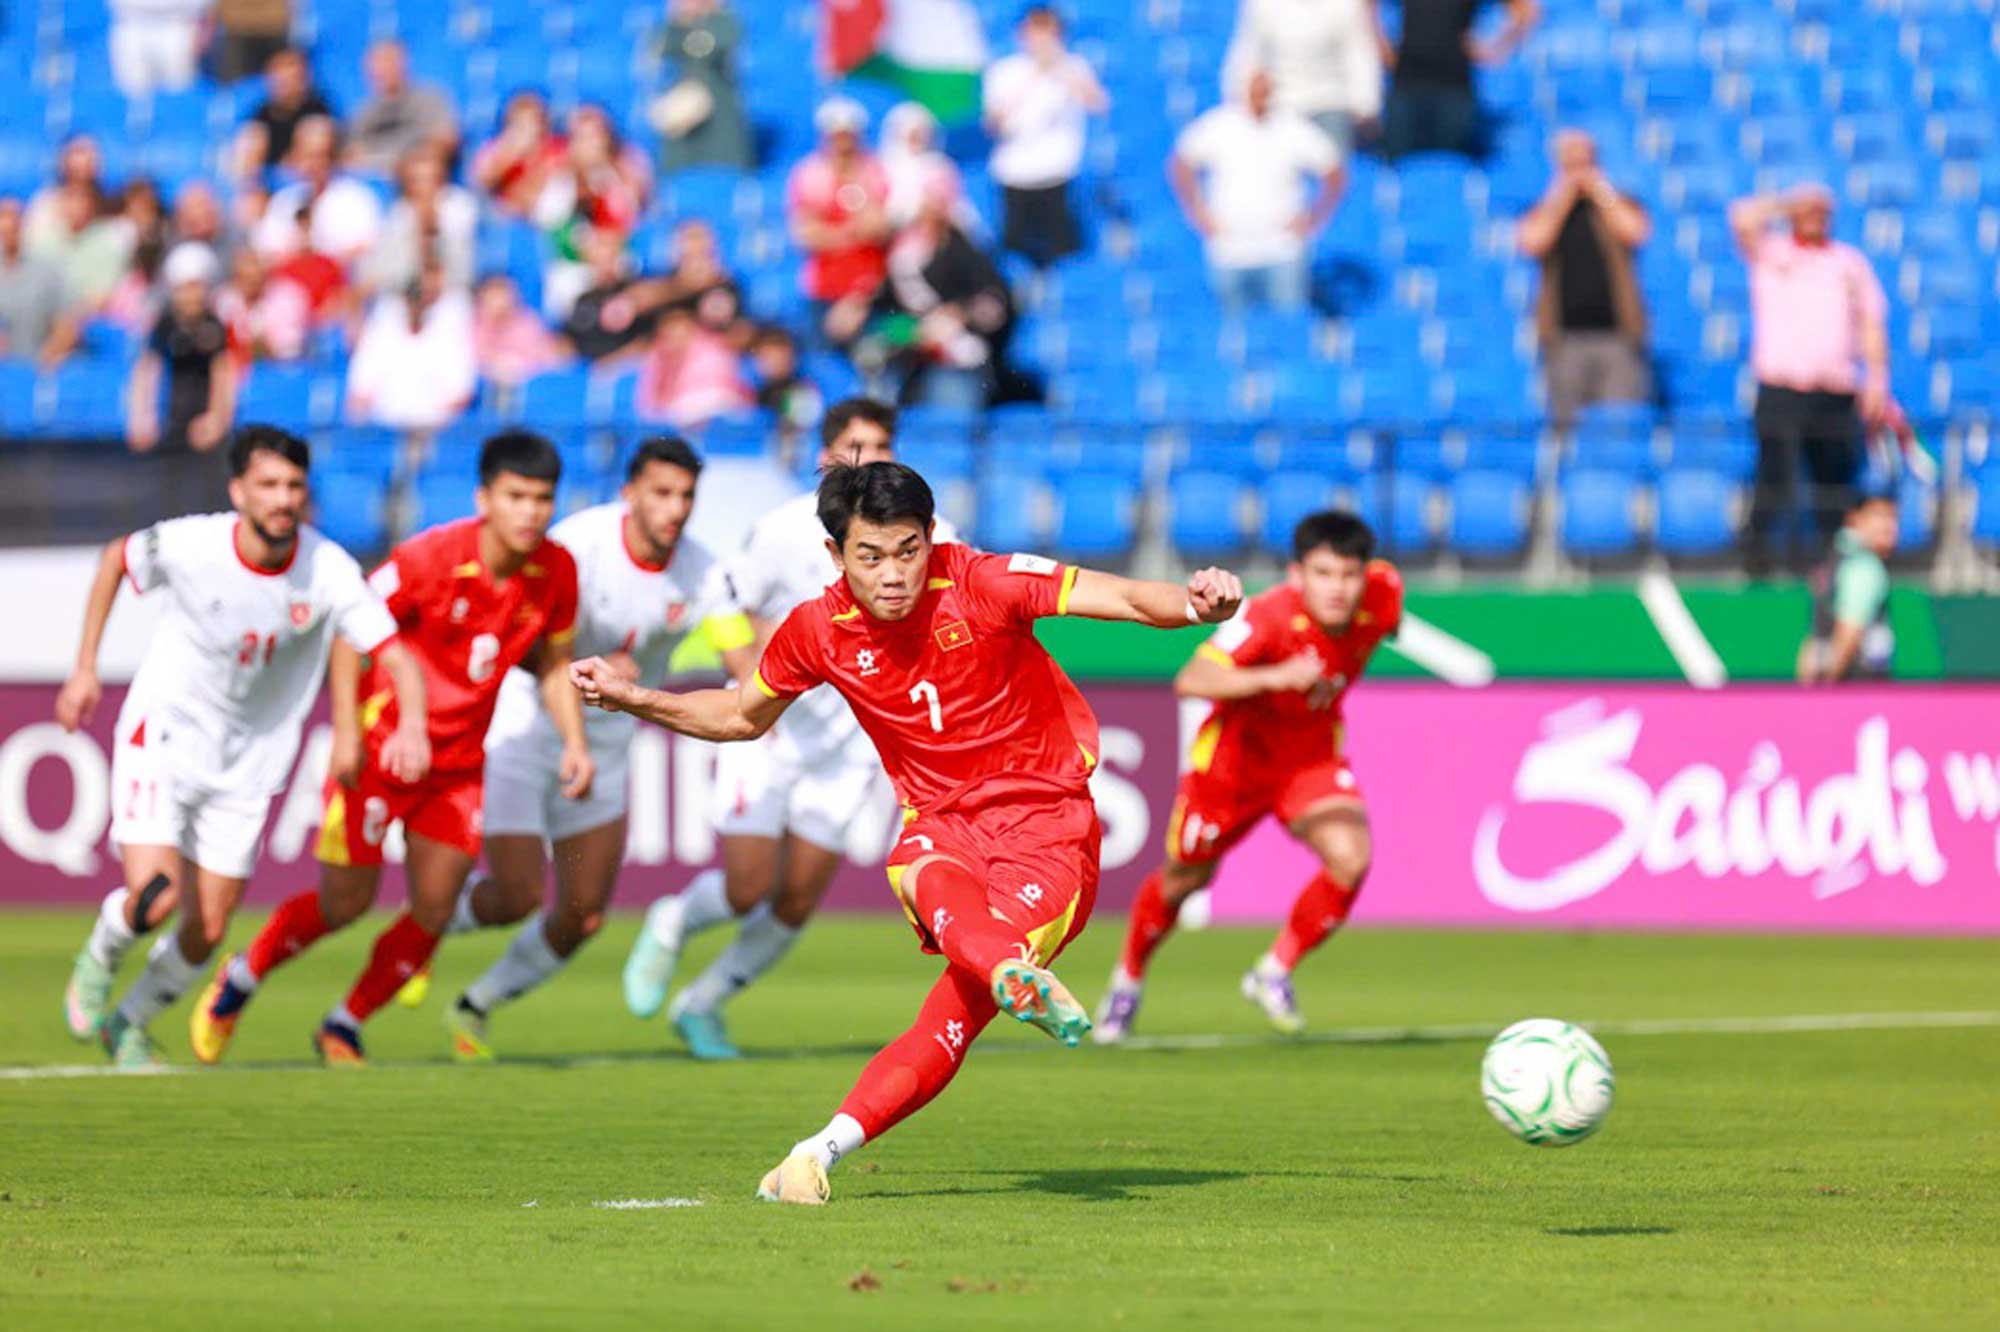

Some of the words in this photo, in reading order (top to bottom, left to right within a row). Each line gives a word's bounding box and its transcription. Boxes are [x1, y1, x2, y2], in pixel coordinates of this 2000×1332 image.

[238, 630, 276, 667] 21
[909, 679, 943, 733] 7
[1472, 699, 1947, 910] Saudi
